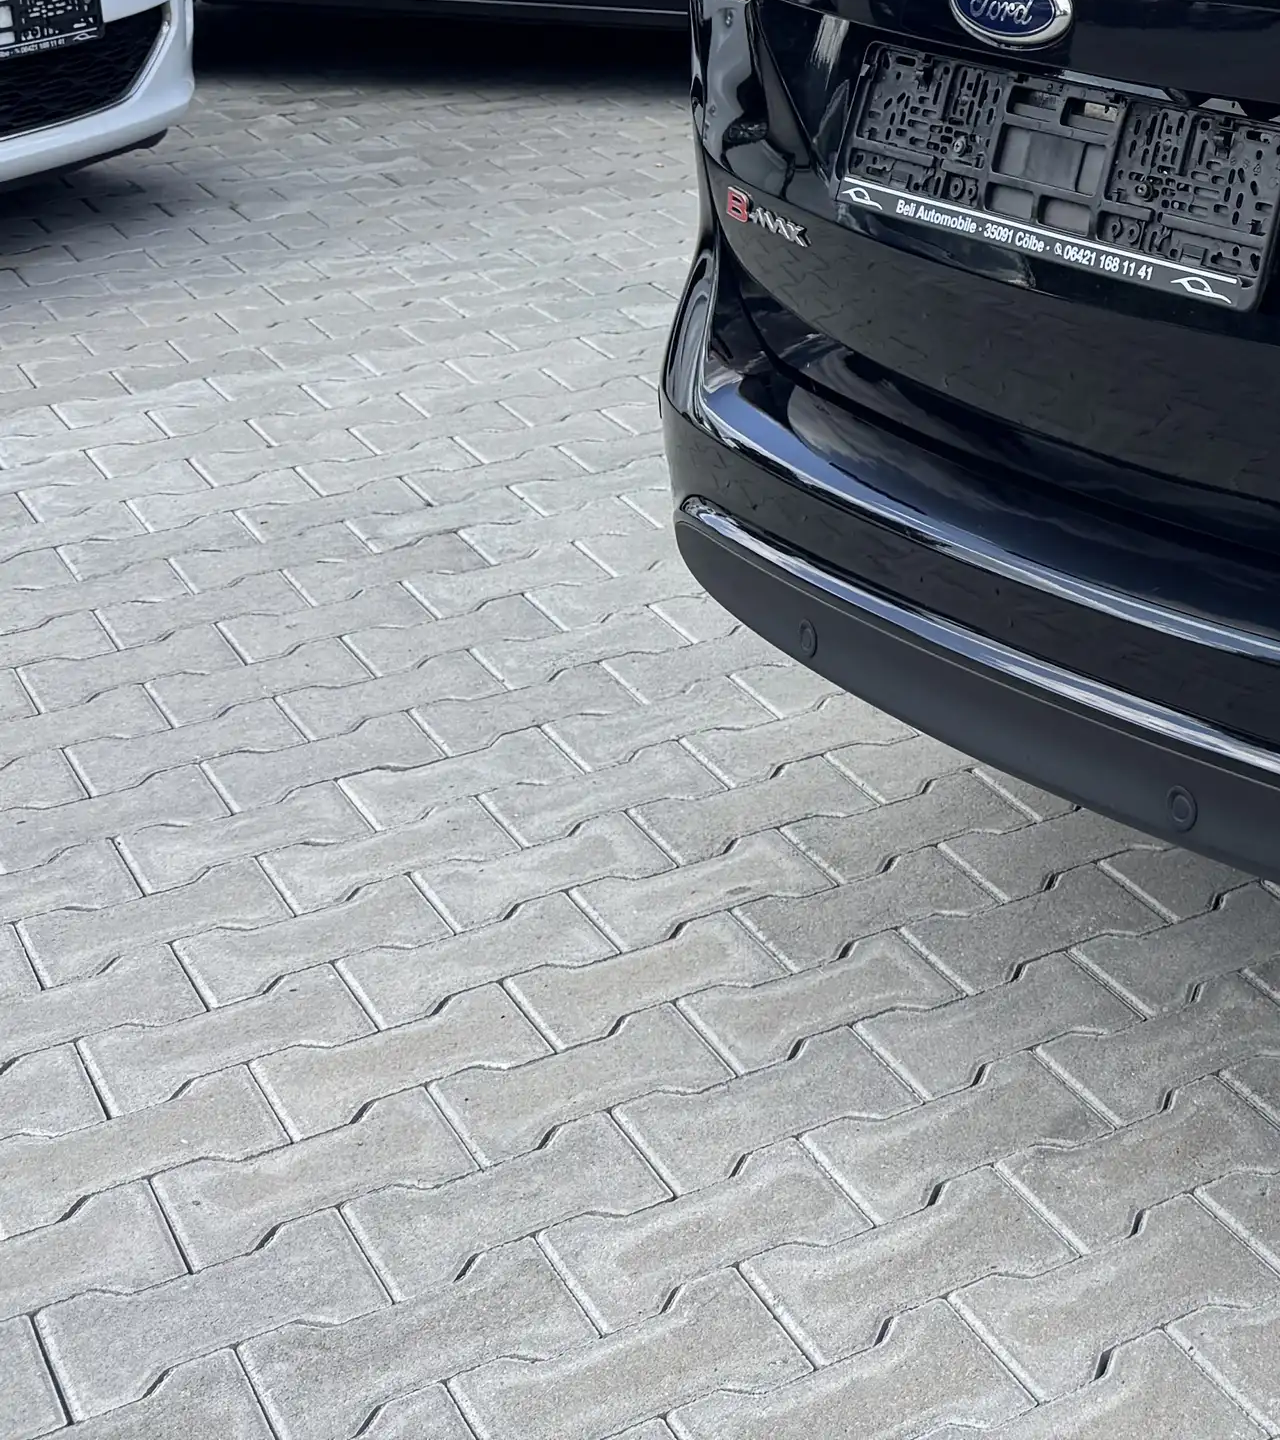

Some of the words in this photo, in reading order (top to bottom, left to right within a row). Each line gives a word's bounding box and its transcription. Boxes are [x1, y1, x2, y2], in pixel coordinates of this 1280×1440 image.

[895, 199, 916, 218] Beli
[916, 205, 977, 233] Automobile
[983, 223, 1014, 243] 35091
[1015, 231, 1045, 252] Cölbe
[1063, 245, 1097, 266] 06421
[1100, 254, 1120, 272] 168
[1122, 260, 1136, 277] 11
[1137, 264, 1153, 280] 41
